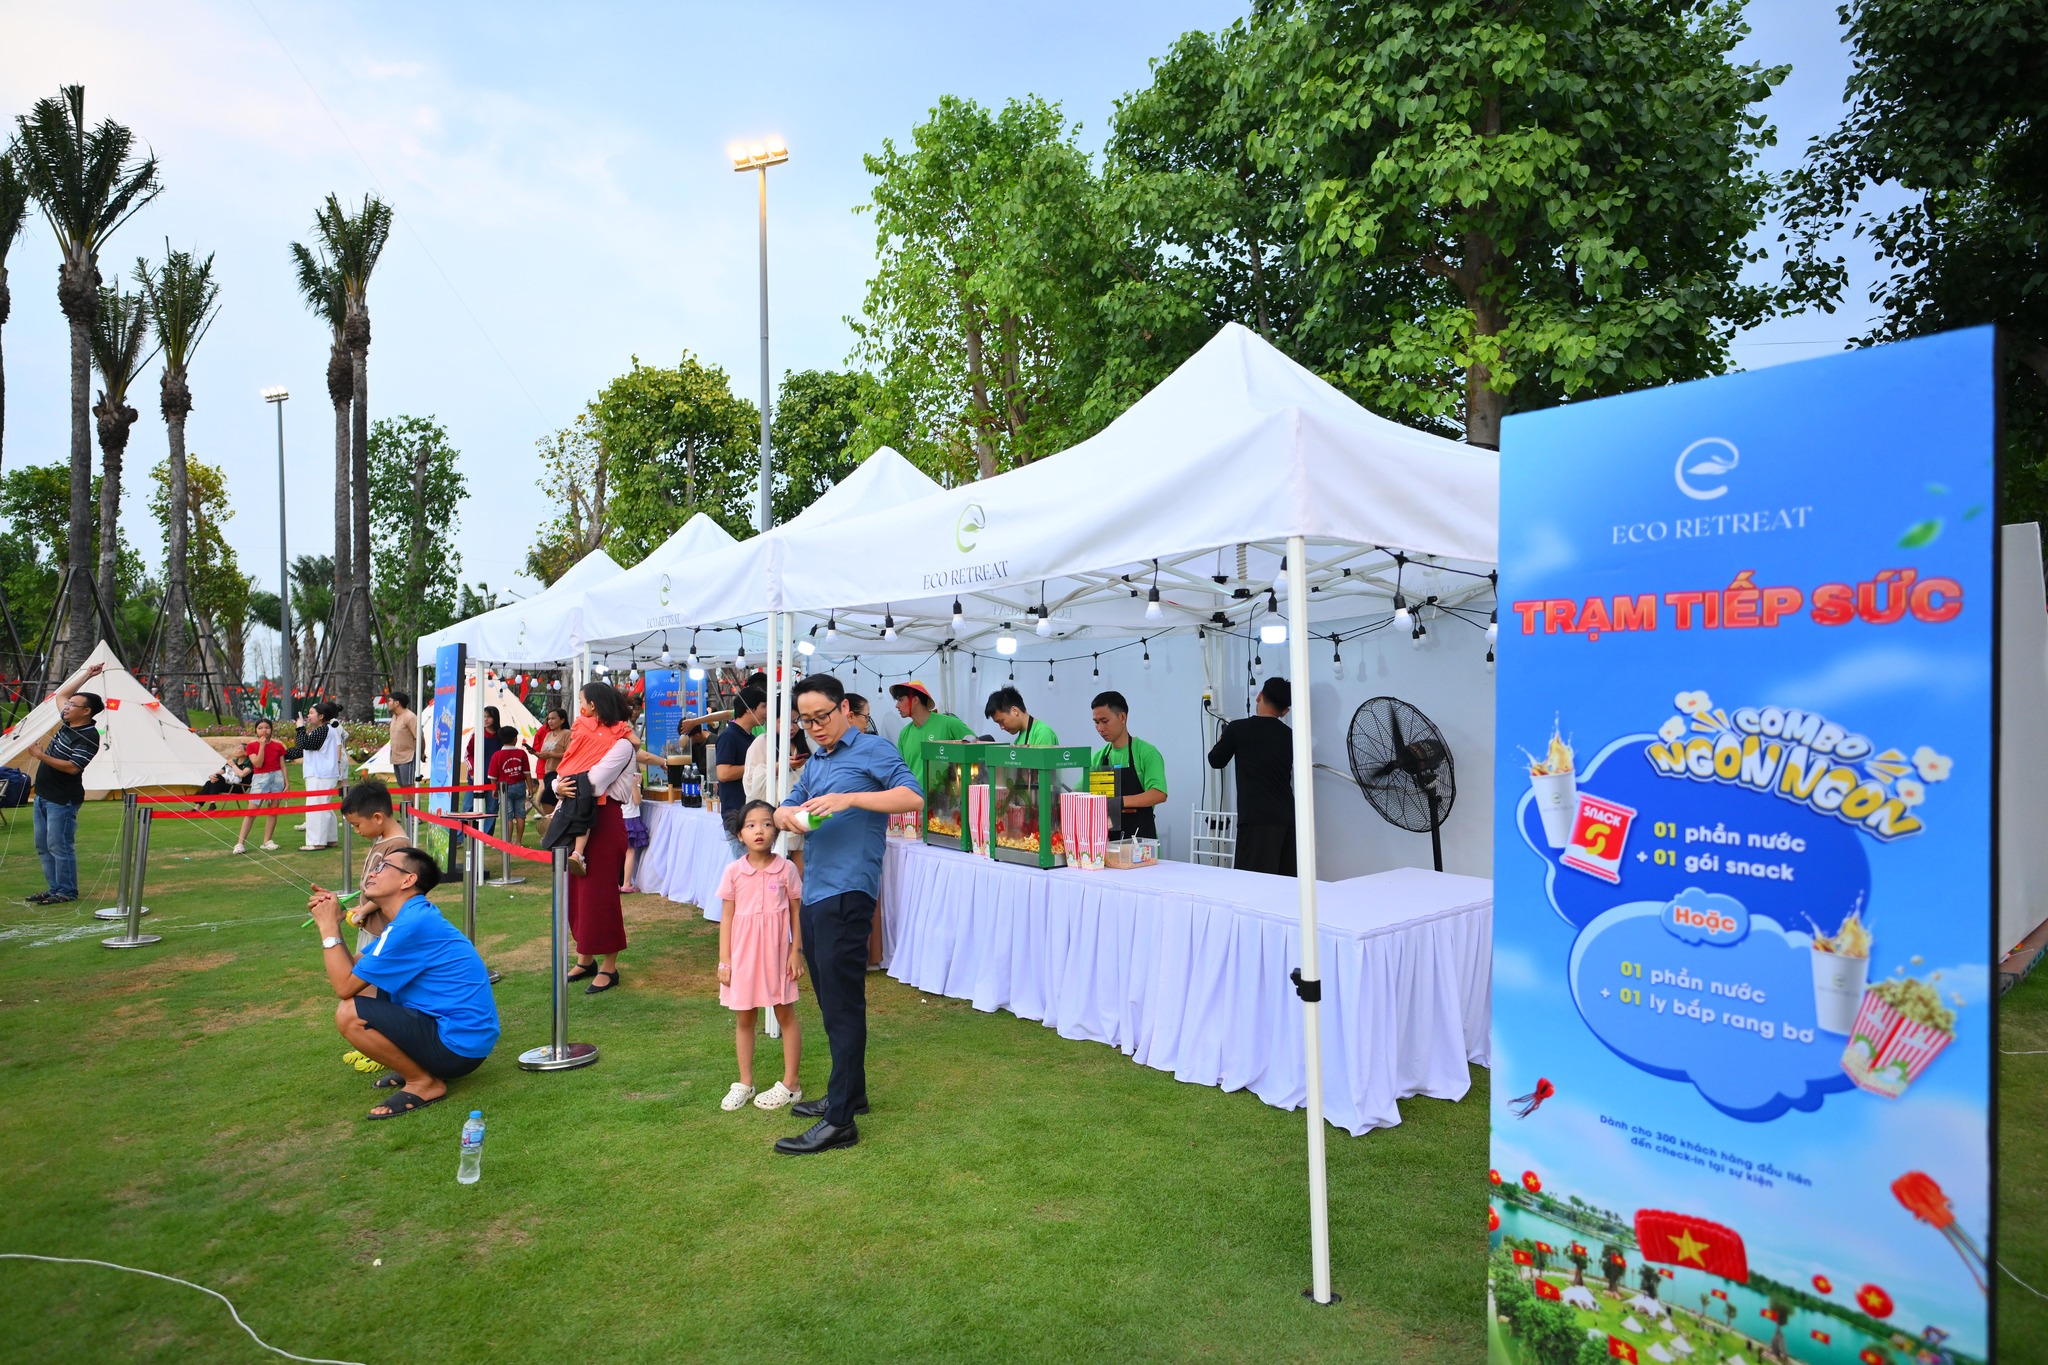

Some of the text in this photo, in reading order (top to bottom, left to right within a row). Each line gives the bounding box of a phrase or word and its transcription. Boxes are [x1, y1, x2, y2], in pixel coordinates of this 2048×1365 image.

[1612, 506, 1814, 544] ECO RETREAT
[923, 560, 1008, 590] ECO RETREAT
[1513, 567, 1964, 641] TRẠM TIẾP SỨC
[1733, 706, 1872, 760] COMBO
[1647, 732, 1924, 840] NGON NGON
[1583, 805, 1622, 828] SNACK
[1654, 821, 1806, 852] 01 phần nước
[1636, 849, 1795, 881] + 01 gói snack
[1674, 906, 1736, 934] Hoặc
[1620, 961, 1767, 1004] 01 phần nước
[1600, 988, 1815, 1044] + 01 ly bắp rang bơ
[1600, 1115, 1629, 1131] Dành
[1631, 1124, 1653, 1138] cho
[1656, 1131, 1677, 1145] 300
[1680, 1139, 1718, 1158] khách
[1720, 1151, 1753, 1171] hàng
[1655, 1145, 1706, 1167] check-in
